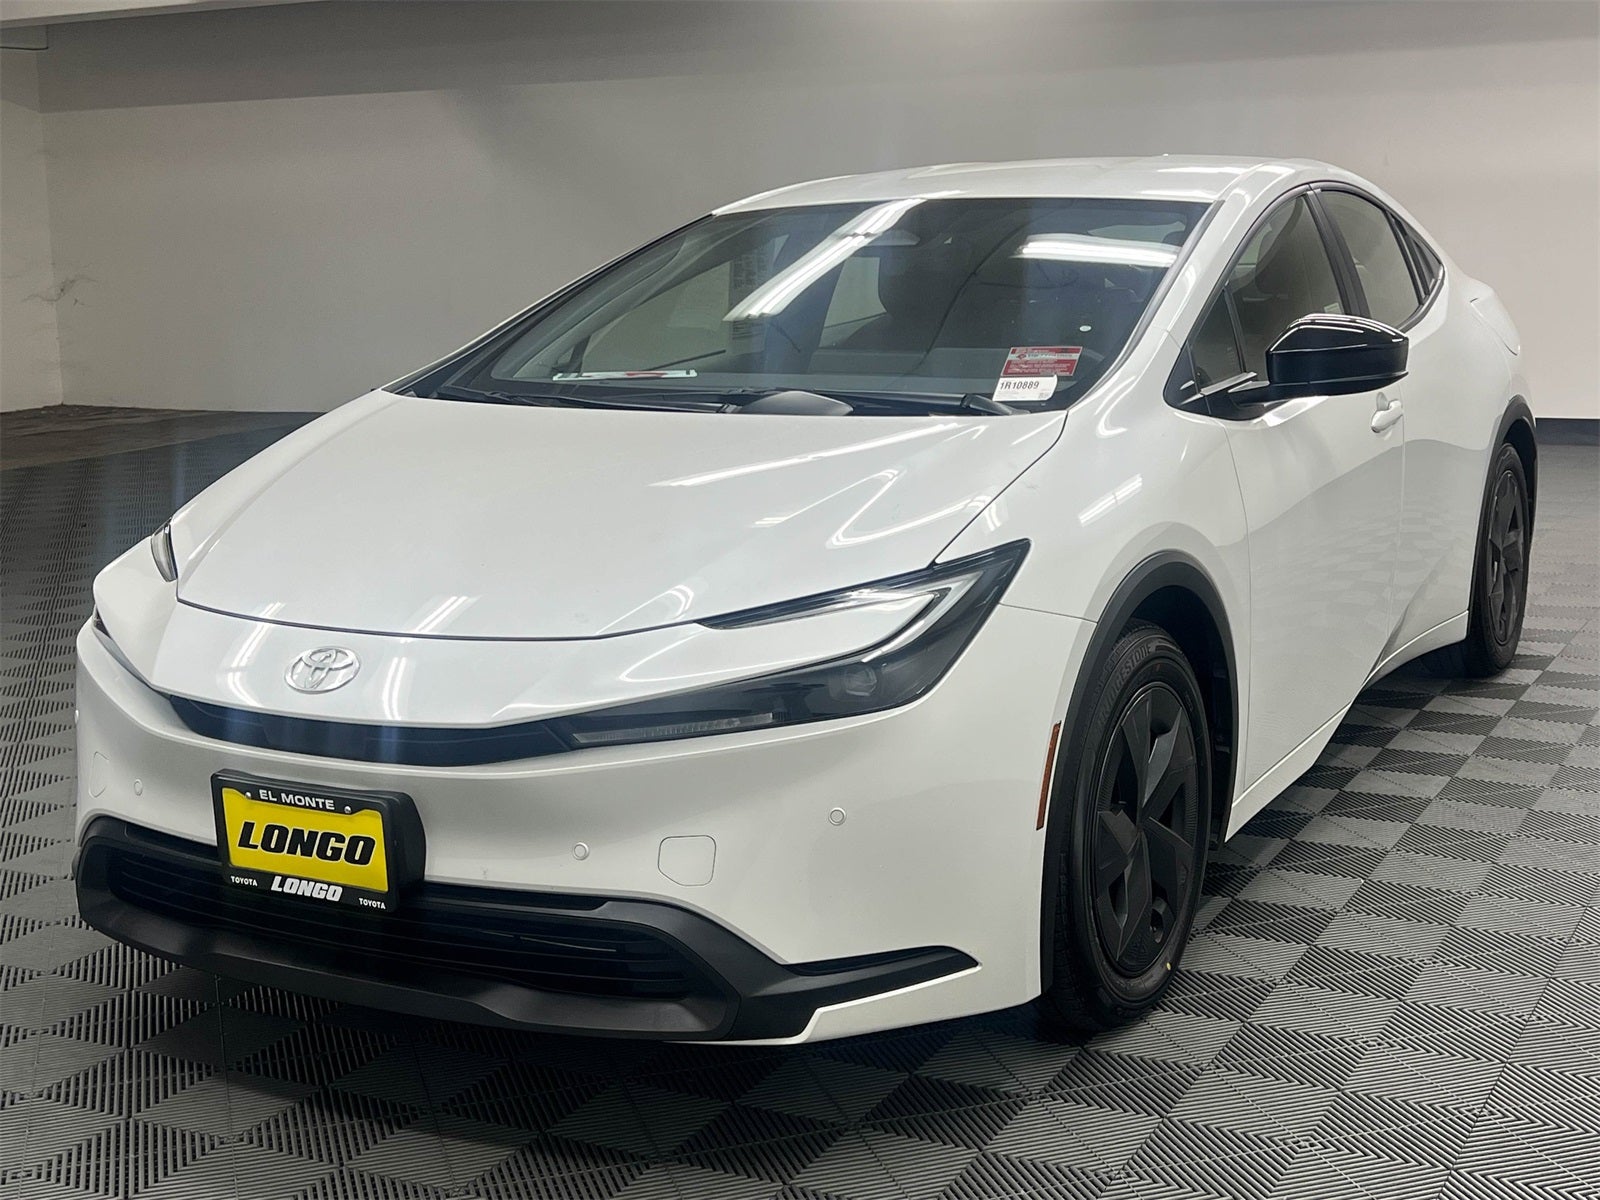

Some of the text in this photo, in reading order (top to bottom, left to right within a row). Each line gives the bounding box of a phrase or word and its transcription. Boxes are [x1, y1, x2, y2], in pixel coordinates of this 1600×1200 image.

[1000, 380, 1040, 390] 1R10889
[259, 789, 335, 810] EL MONTE
[237, 820, 377, 867] LONGO
[230, 876, 258, 887] TOYOTA
[270, 875, 343, 902] LONGO
[358, 897, 386, 910] TOYOTA
